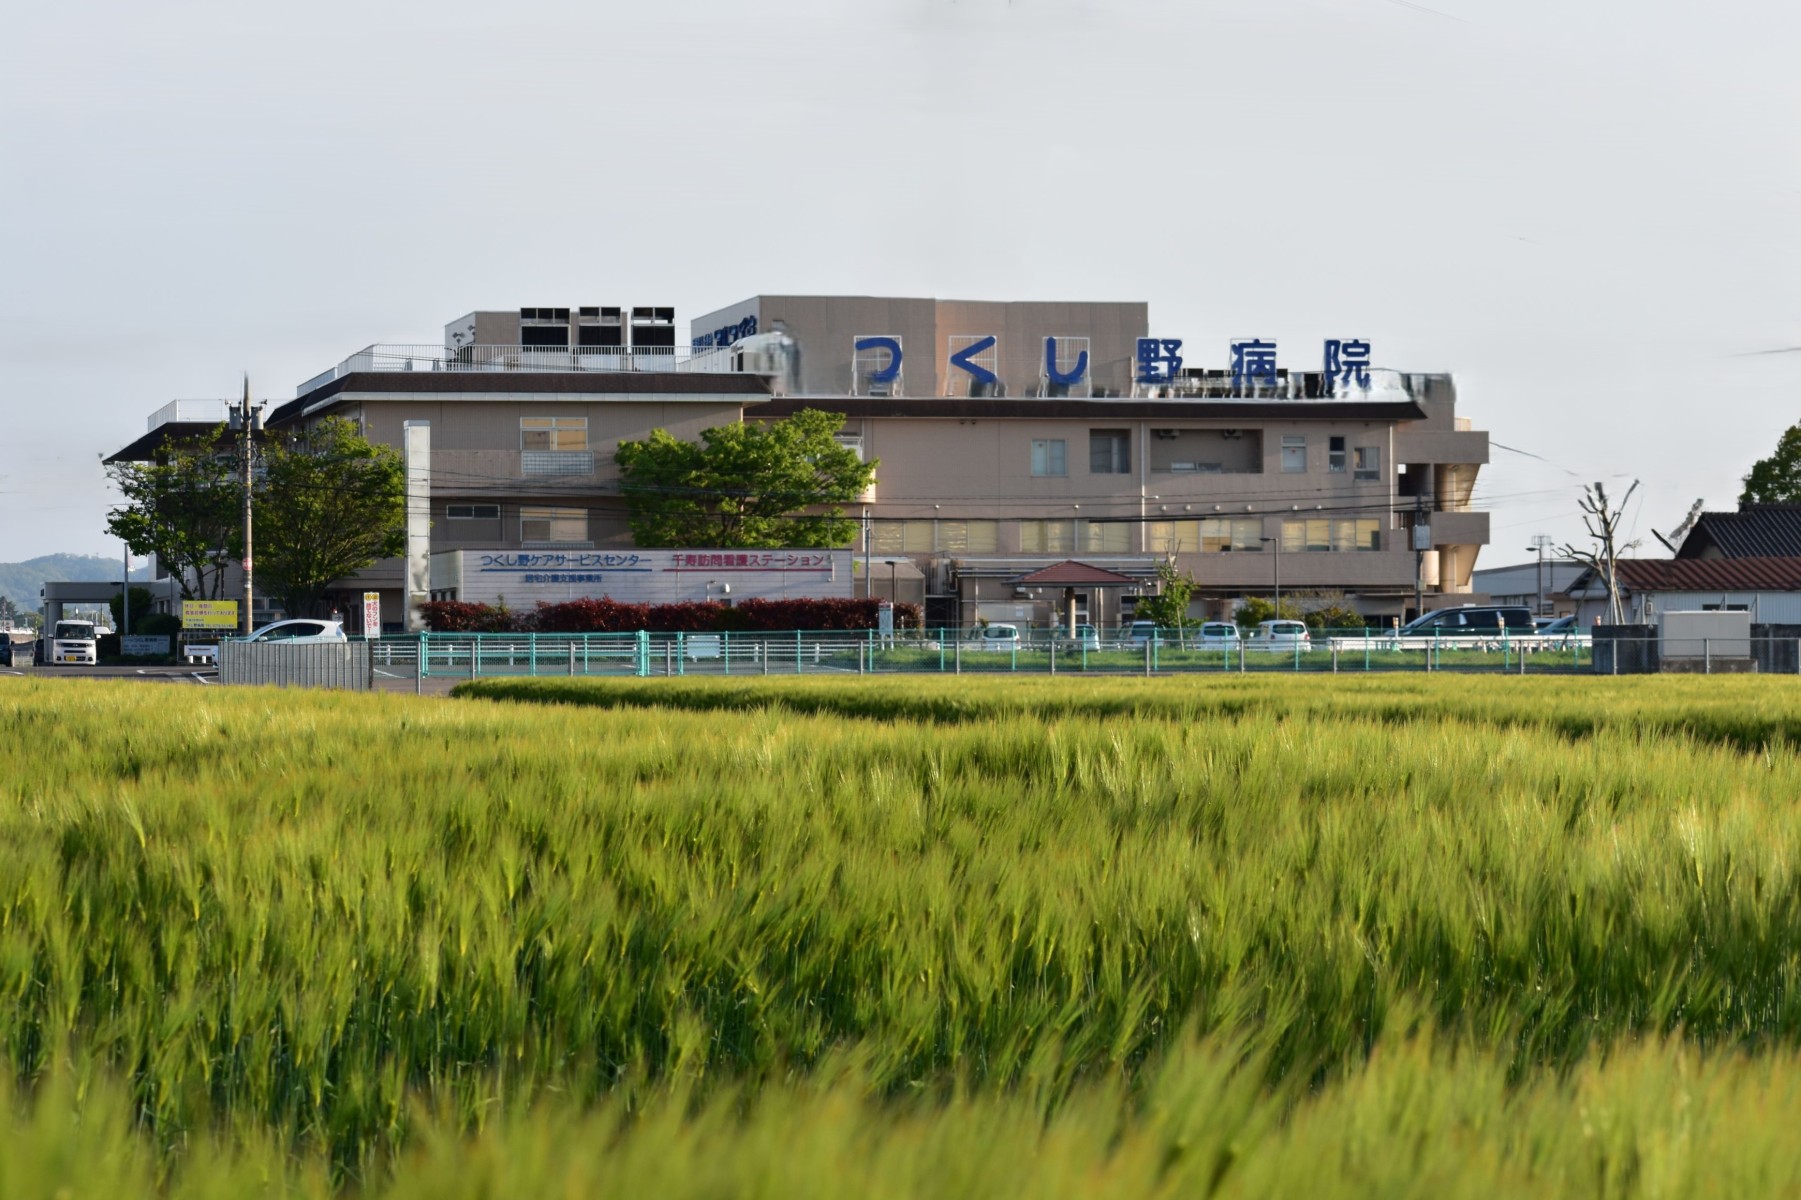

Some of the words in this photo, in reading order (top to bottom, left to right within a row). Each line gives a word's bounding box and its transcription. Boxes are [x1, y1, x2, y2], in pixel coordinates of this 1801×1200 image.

[853, 335, 1371, 386] つくし野病院
[480, 554, 653, 567] つくし野ケアサービスセンター
[671, 554, 825, 567] 千寿訪問看護ステーション
